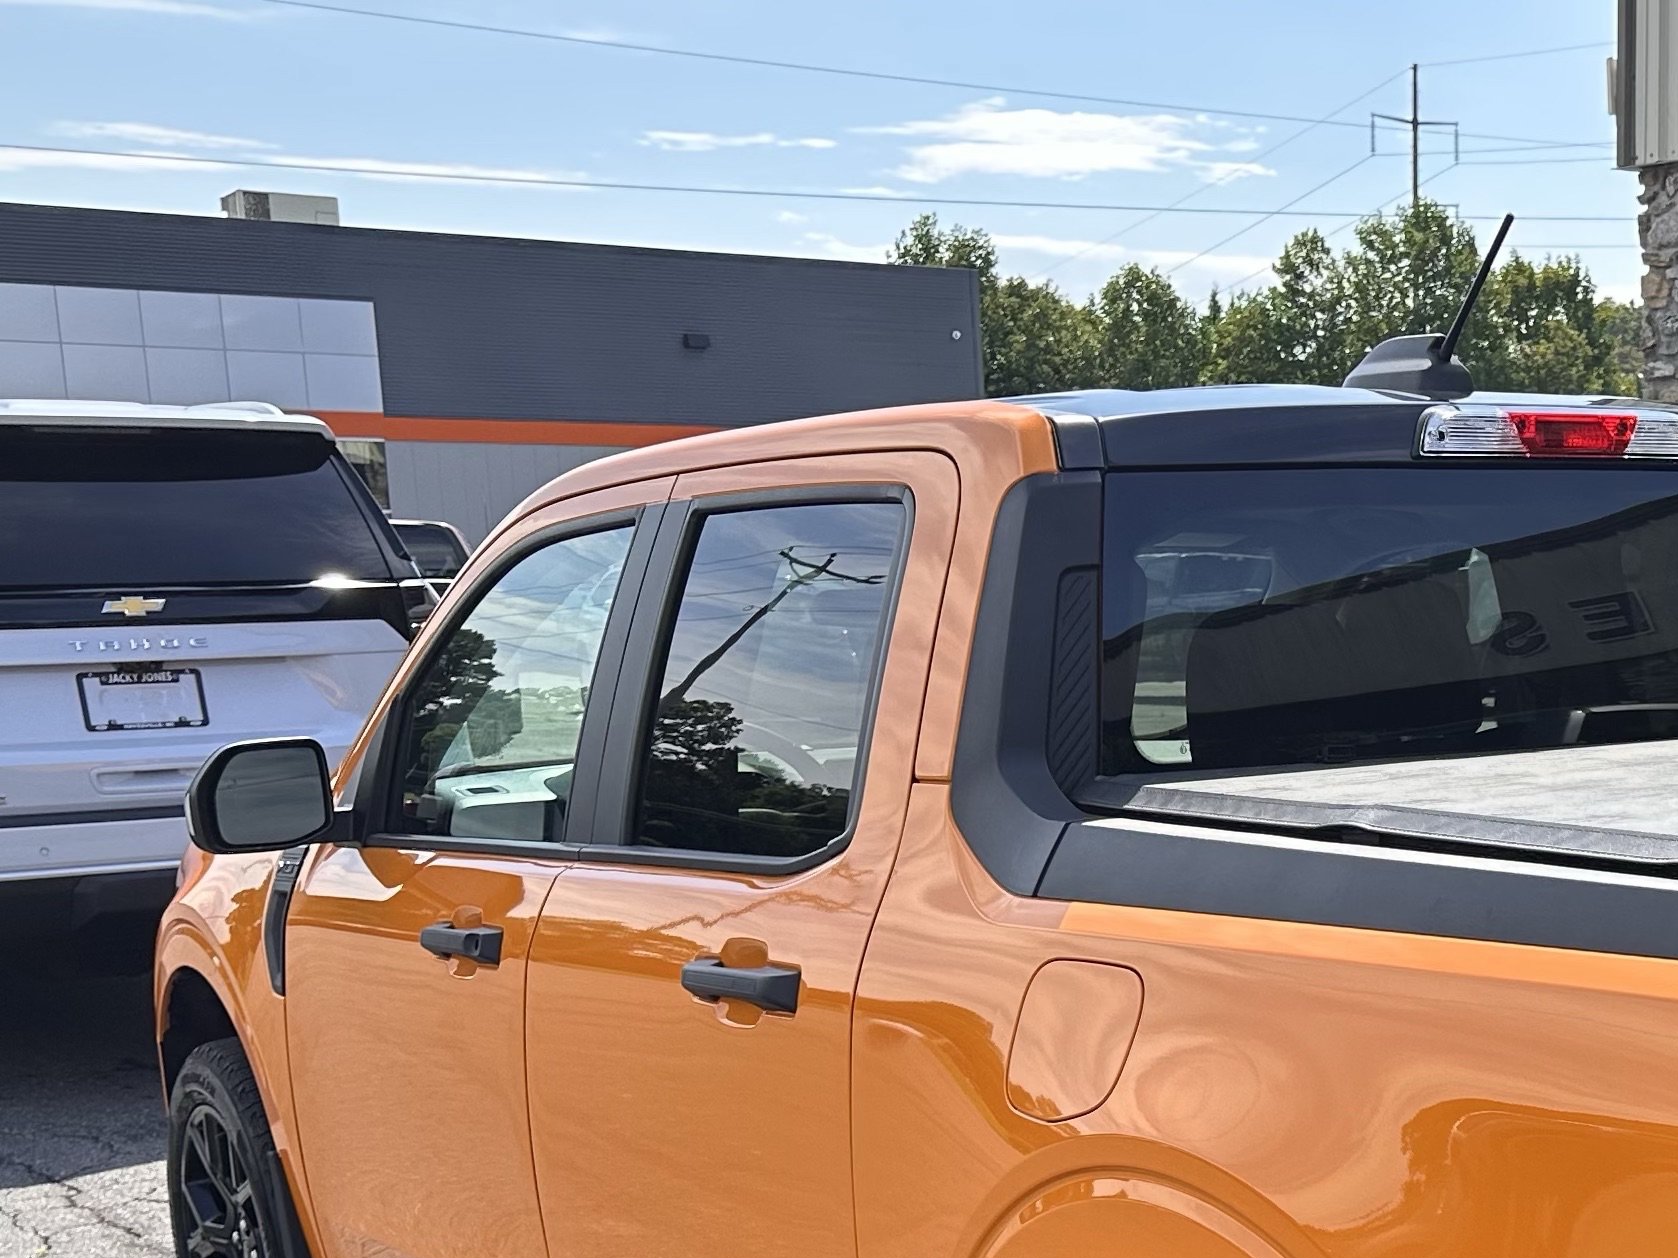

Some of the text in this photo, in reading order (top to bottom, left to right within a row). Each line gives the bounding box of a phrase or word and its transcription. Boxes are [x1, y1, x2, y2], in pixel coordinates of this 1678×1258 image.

[68, 637, 209, 651] TAHOE
[109, 671, 173, 684] JACKY JONES
